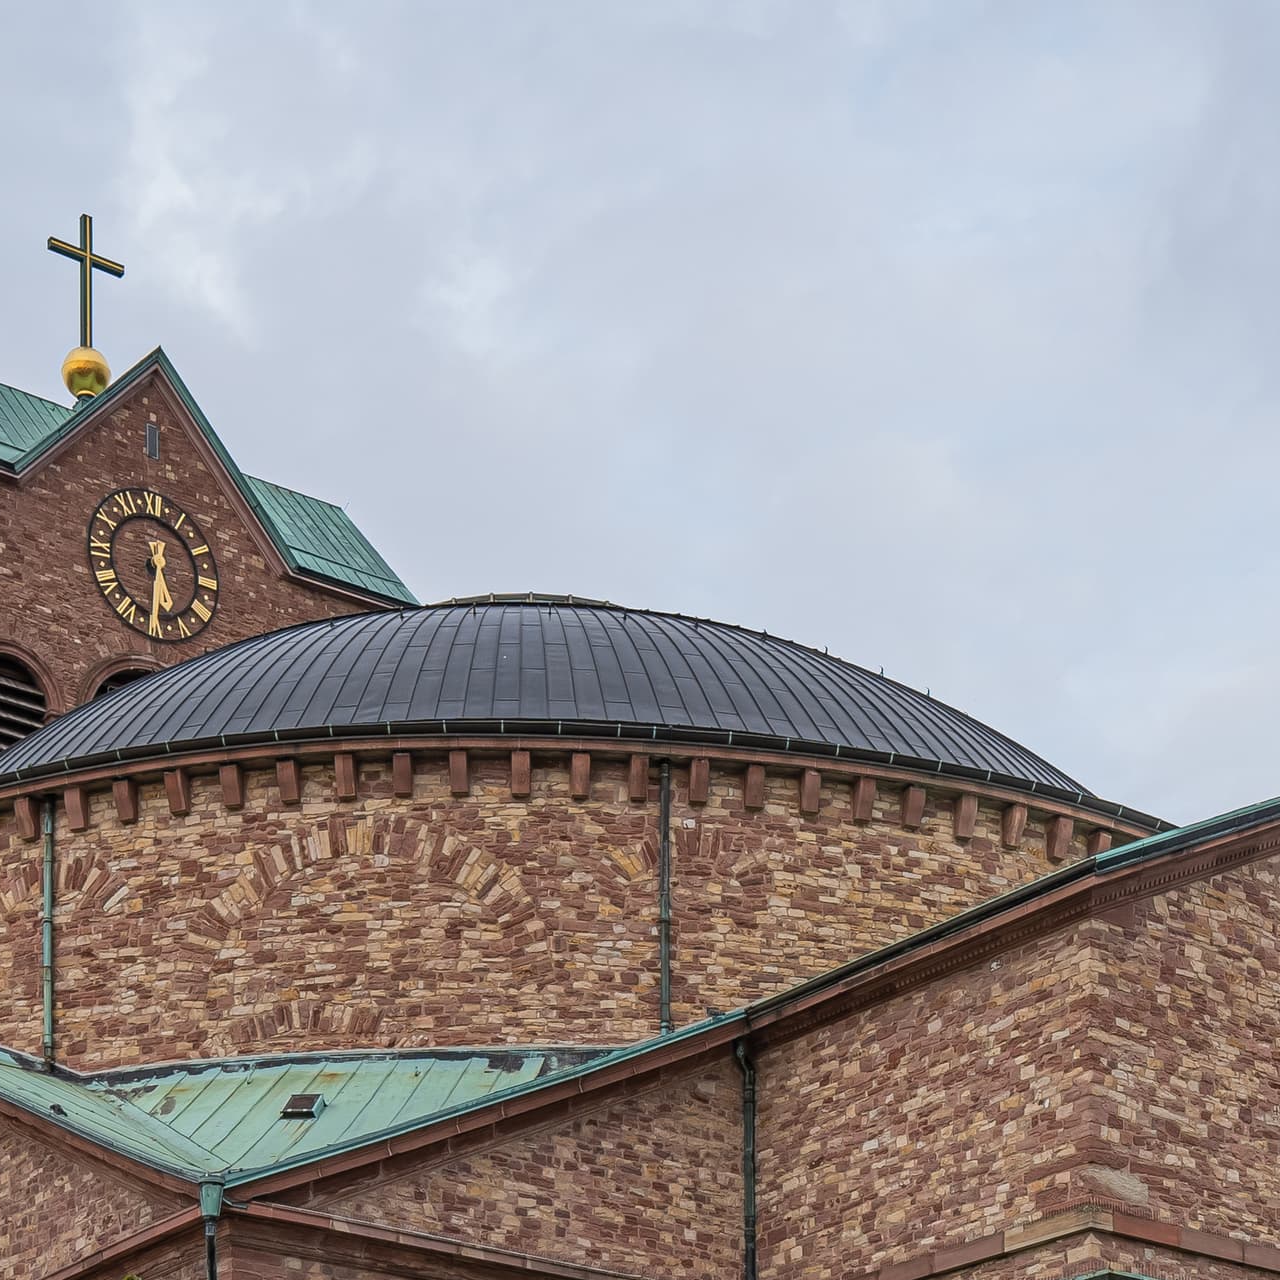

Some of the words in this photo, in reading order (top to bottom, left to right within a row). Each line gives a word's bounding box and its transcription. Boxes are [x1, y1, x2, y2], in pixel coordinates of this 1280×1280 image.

[114, 491, 137, 517] XI
[144, 491, 162, 517] XII
[96, 508, 117, 530] X
[90, 536, 111, 558] IX
[191, 544, 209, 556] II
[95, 569, 118, 595] VIII
[198, 576, 217, 591] III
[116, 596, 137, 624] VII
[177, 616, 192, 638] V
